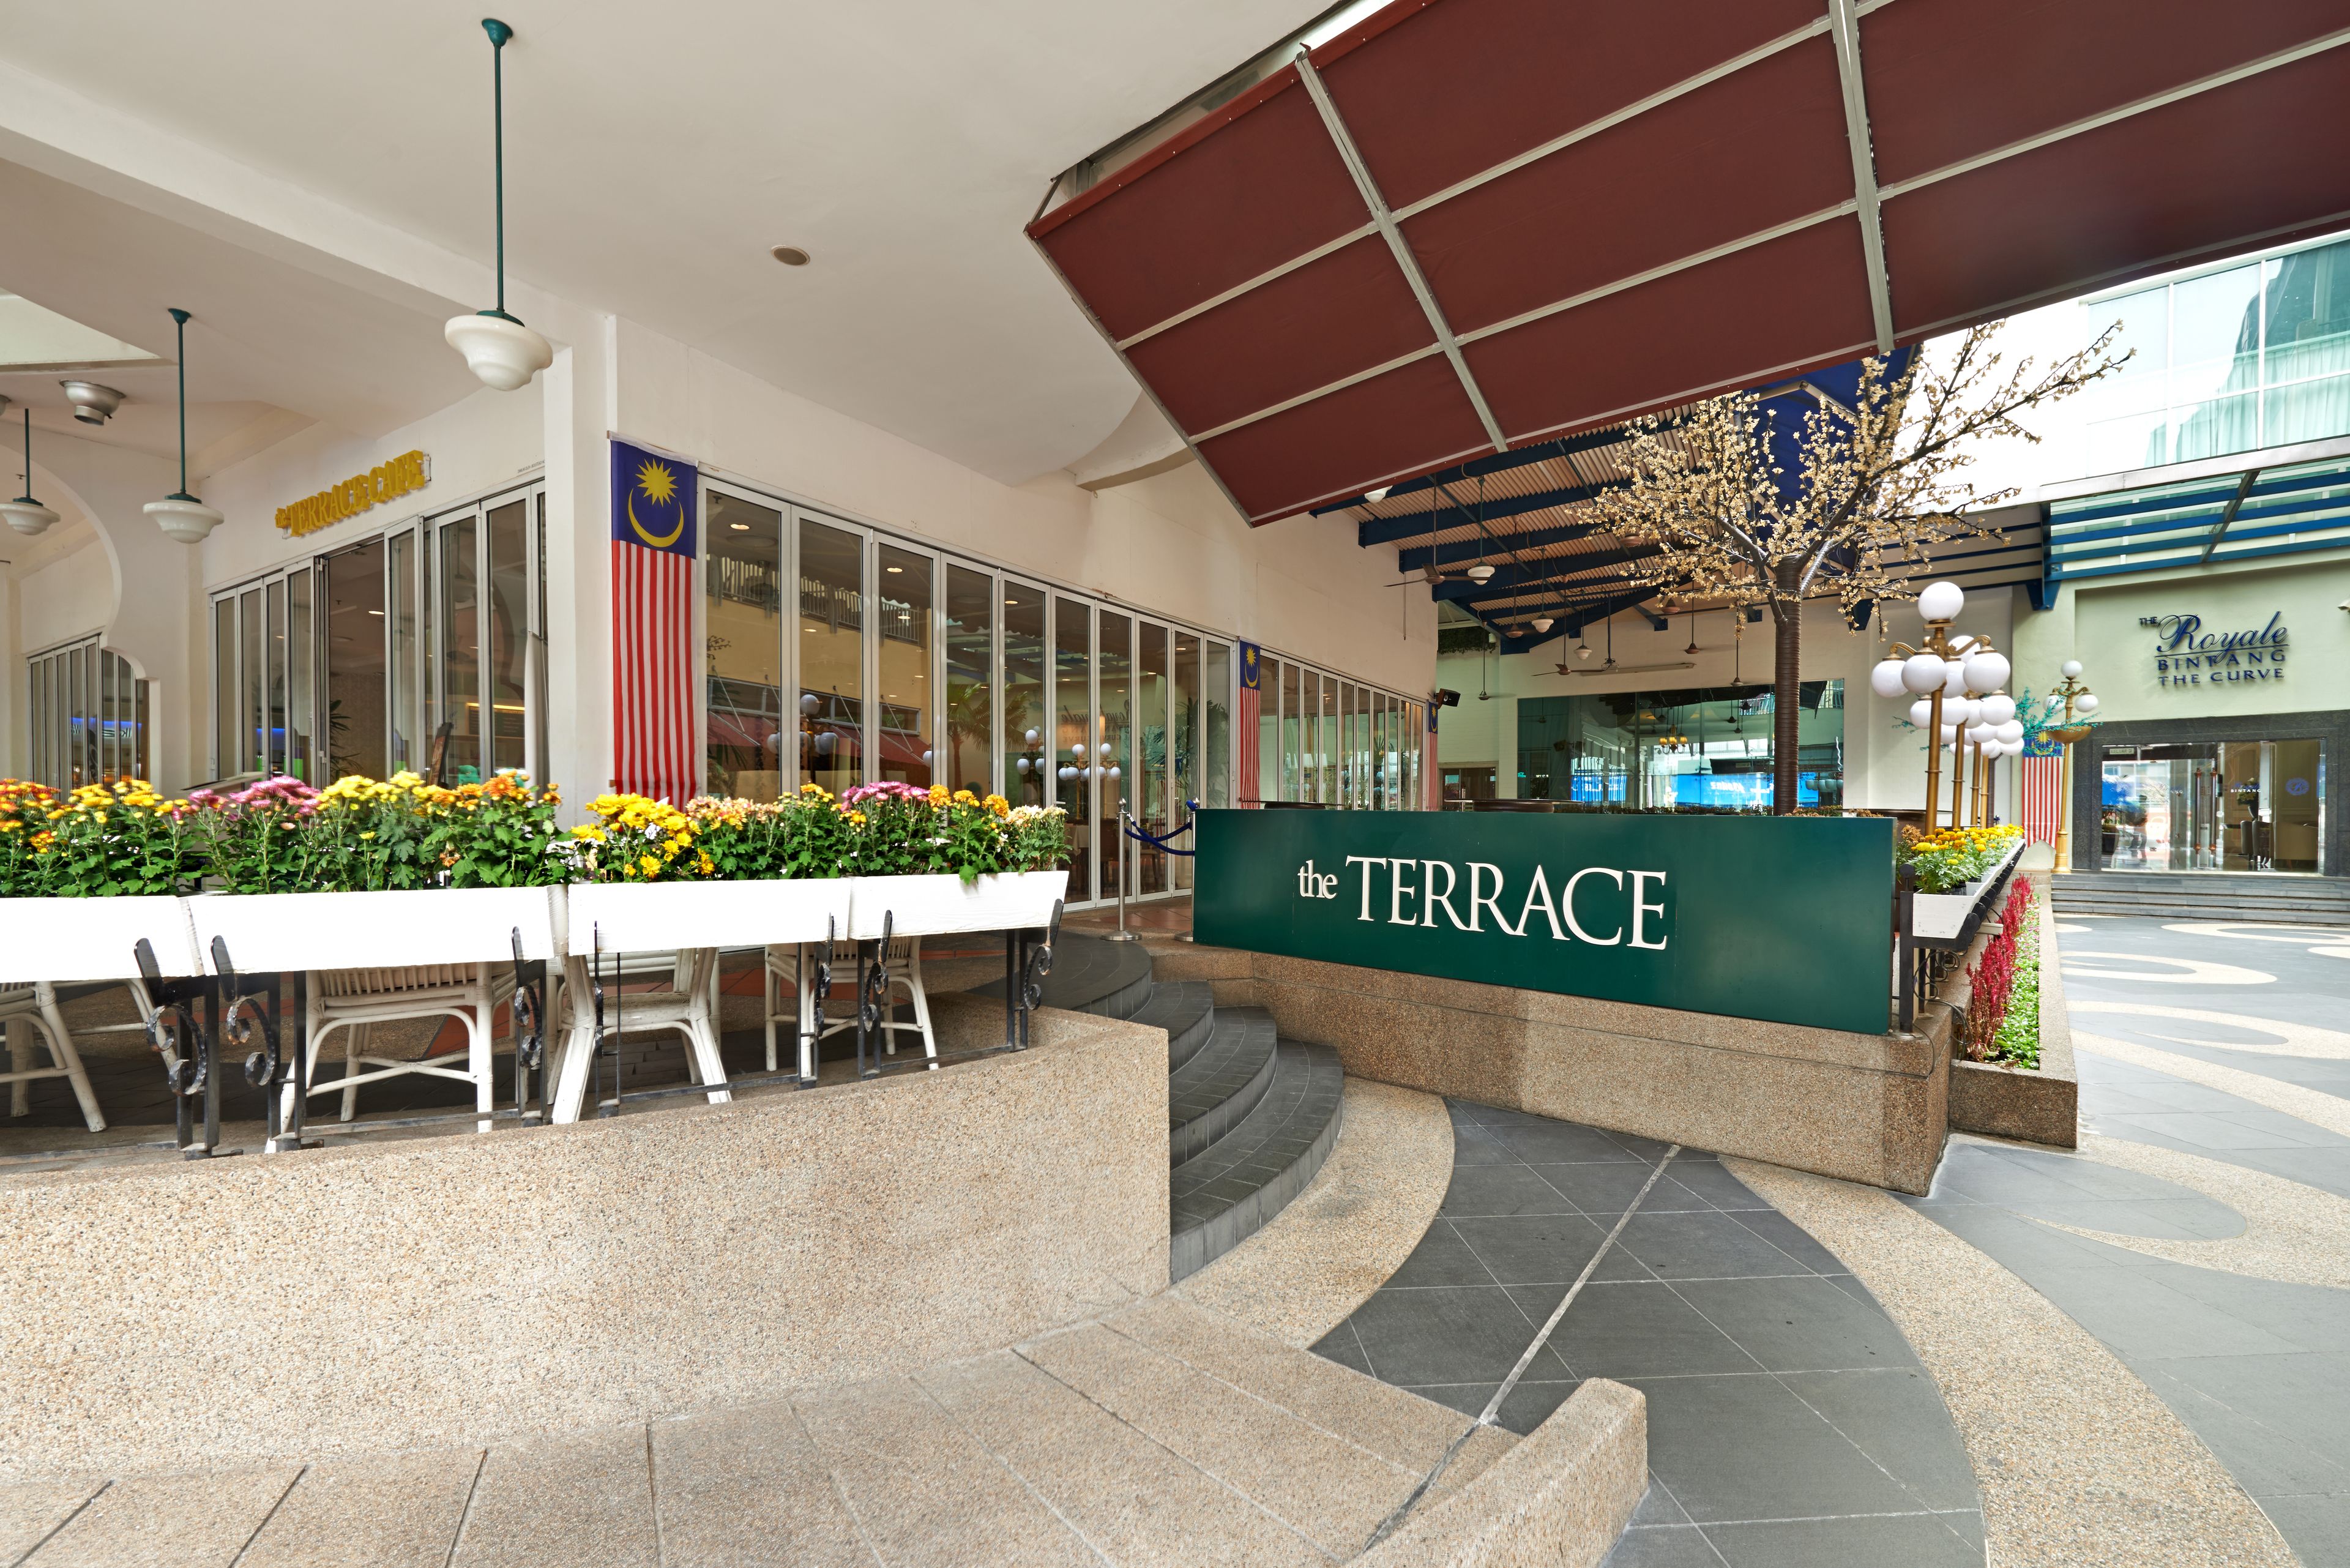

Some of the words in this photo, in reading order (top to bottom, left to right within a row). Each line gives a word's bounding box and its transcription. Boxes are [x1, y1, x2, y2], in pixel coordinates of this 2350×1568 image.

[275, 507, 291, 529] the
[286, 474, 371, 537] TERRACE
[368, 450, 426, 504] CAFE
[2139, 616, 2158, 627] THE
[2156, 611, 2289, 663] Royale
[2158, 649, 2286, 671] BINTANG
[2158, 674, 2201, 686] THE
[2210, 668, 2285, 682] CURVE
[1297, 859, 1338, 899] the
[1346, 855, 1668, 950] TERRACE
